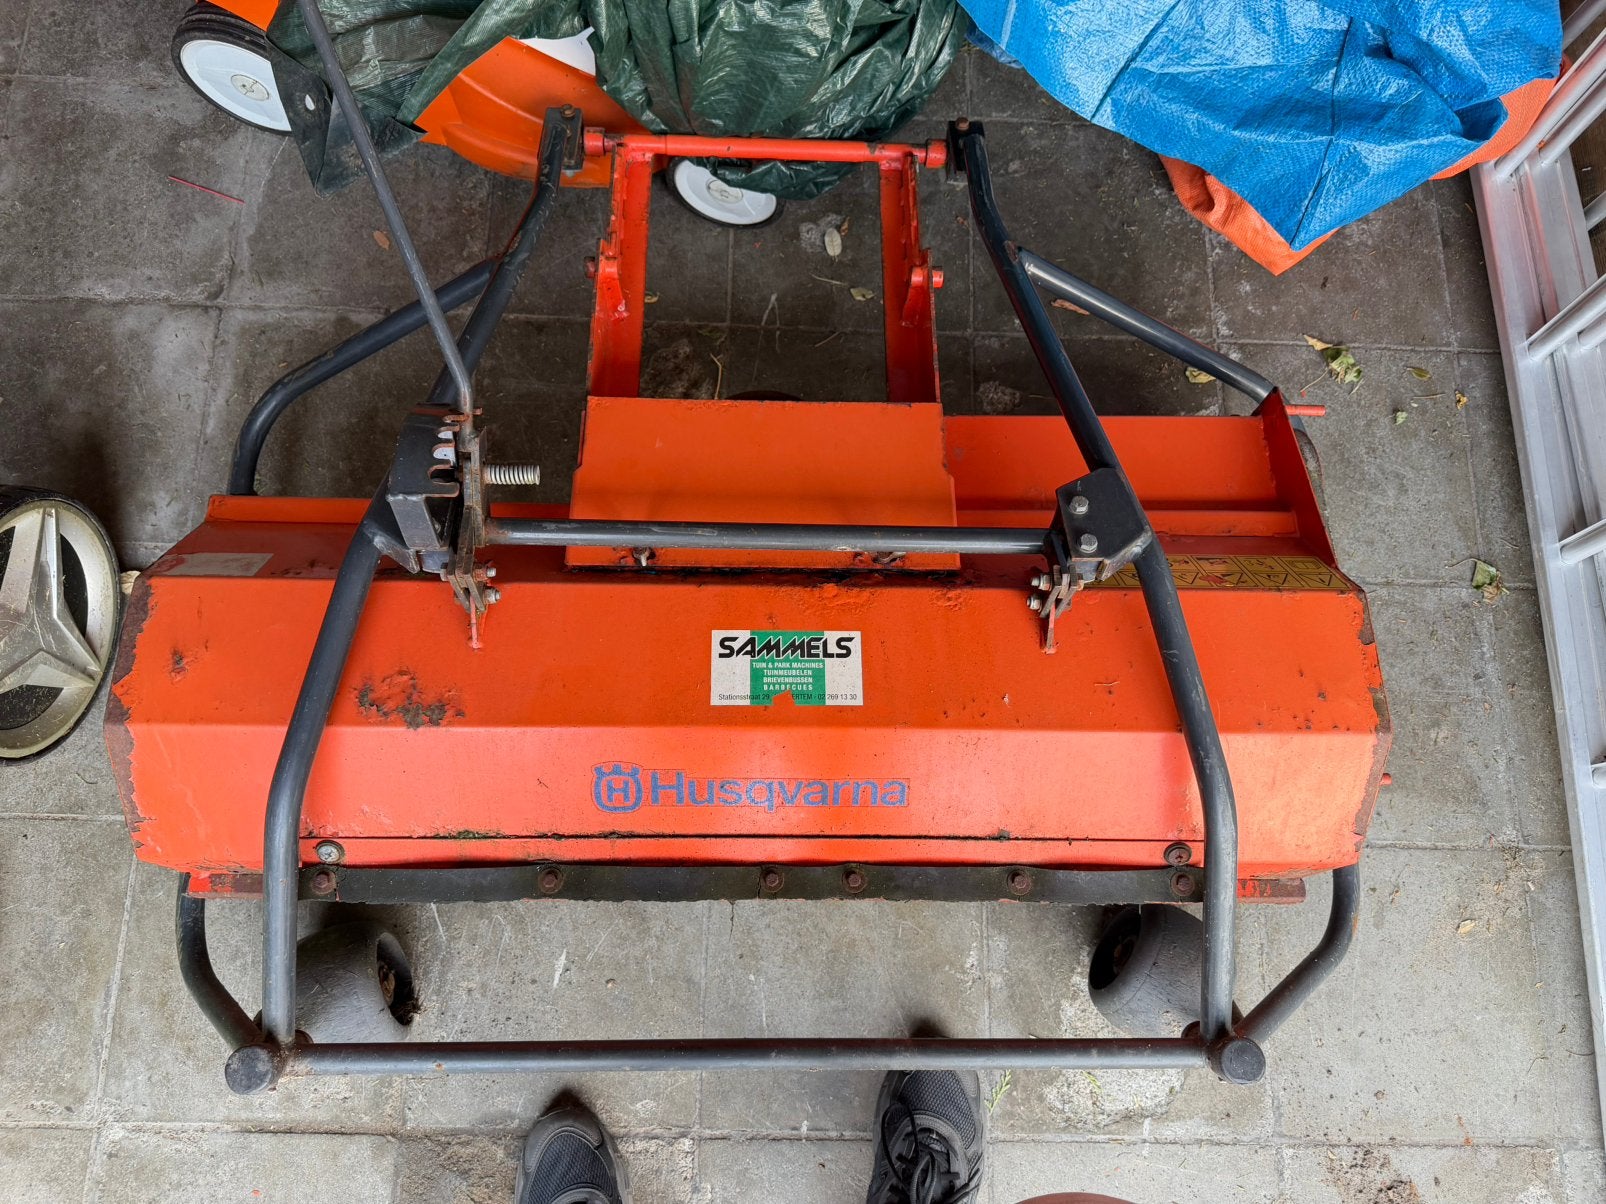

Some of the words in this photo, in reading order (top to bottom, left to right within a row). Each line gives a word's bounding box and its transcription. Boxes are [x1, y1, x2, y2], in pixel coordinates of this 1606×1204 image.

[718, 636, 856, 659] SAMMELS
[718, 693, 760, 701] Stationsstraat
[840, 693, 848, 701] 13
[849, 693, 858, 701] 30
[650, 771, 907, 811] Husqvarna
